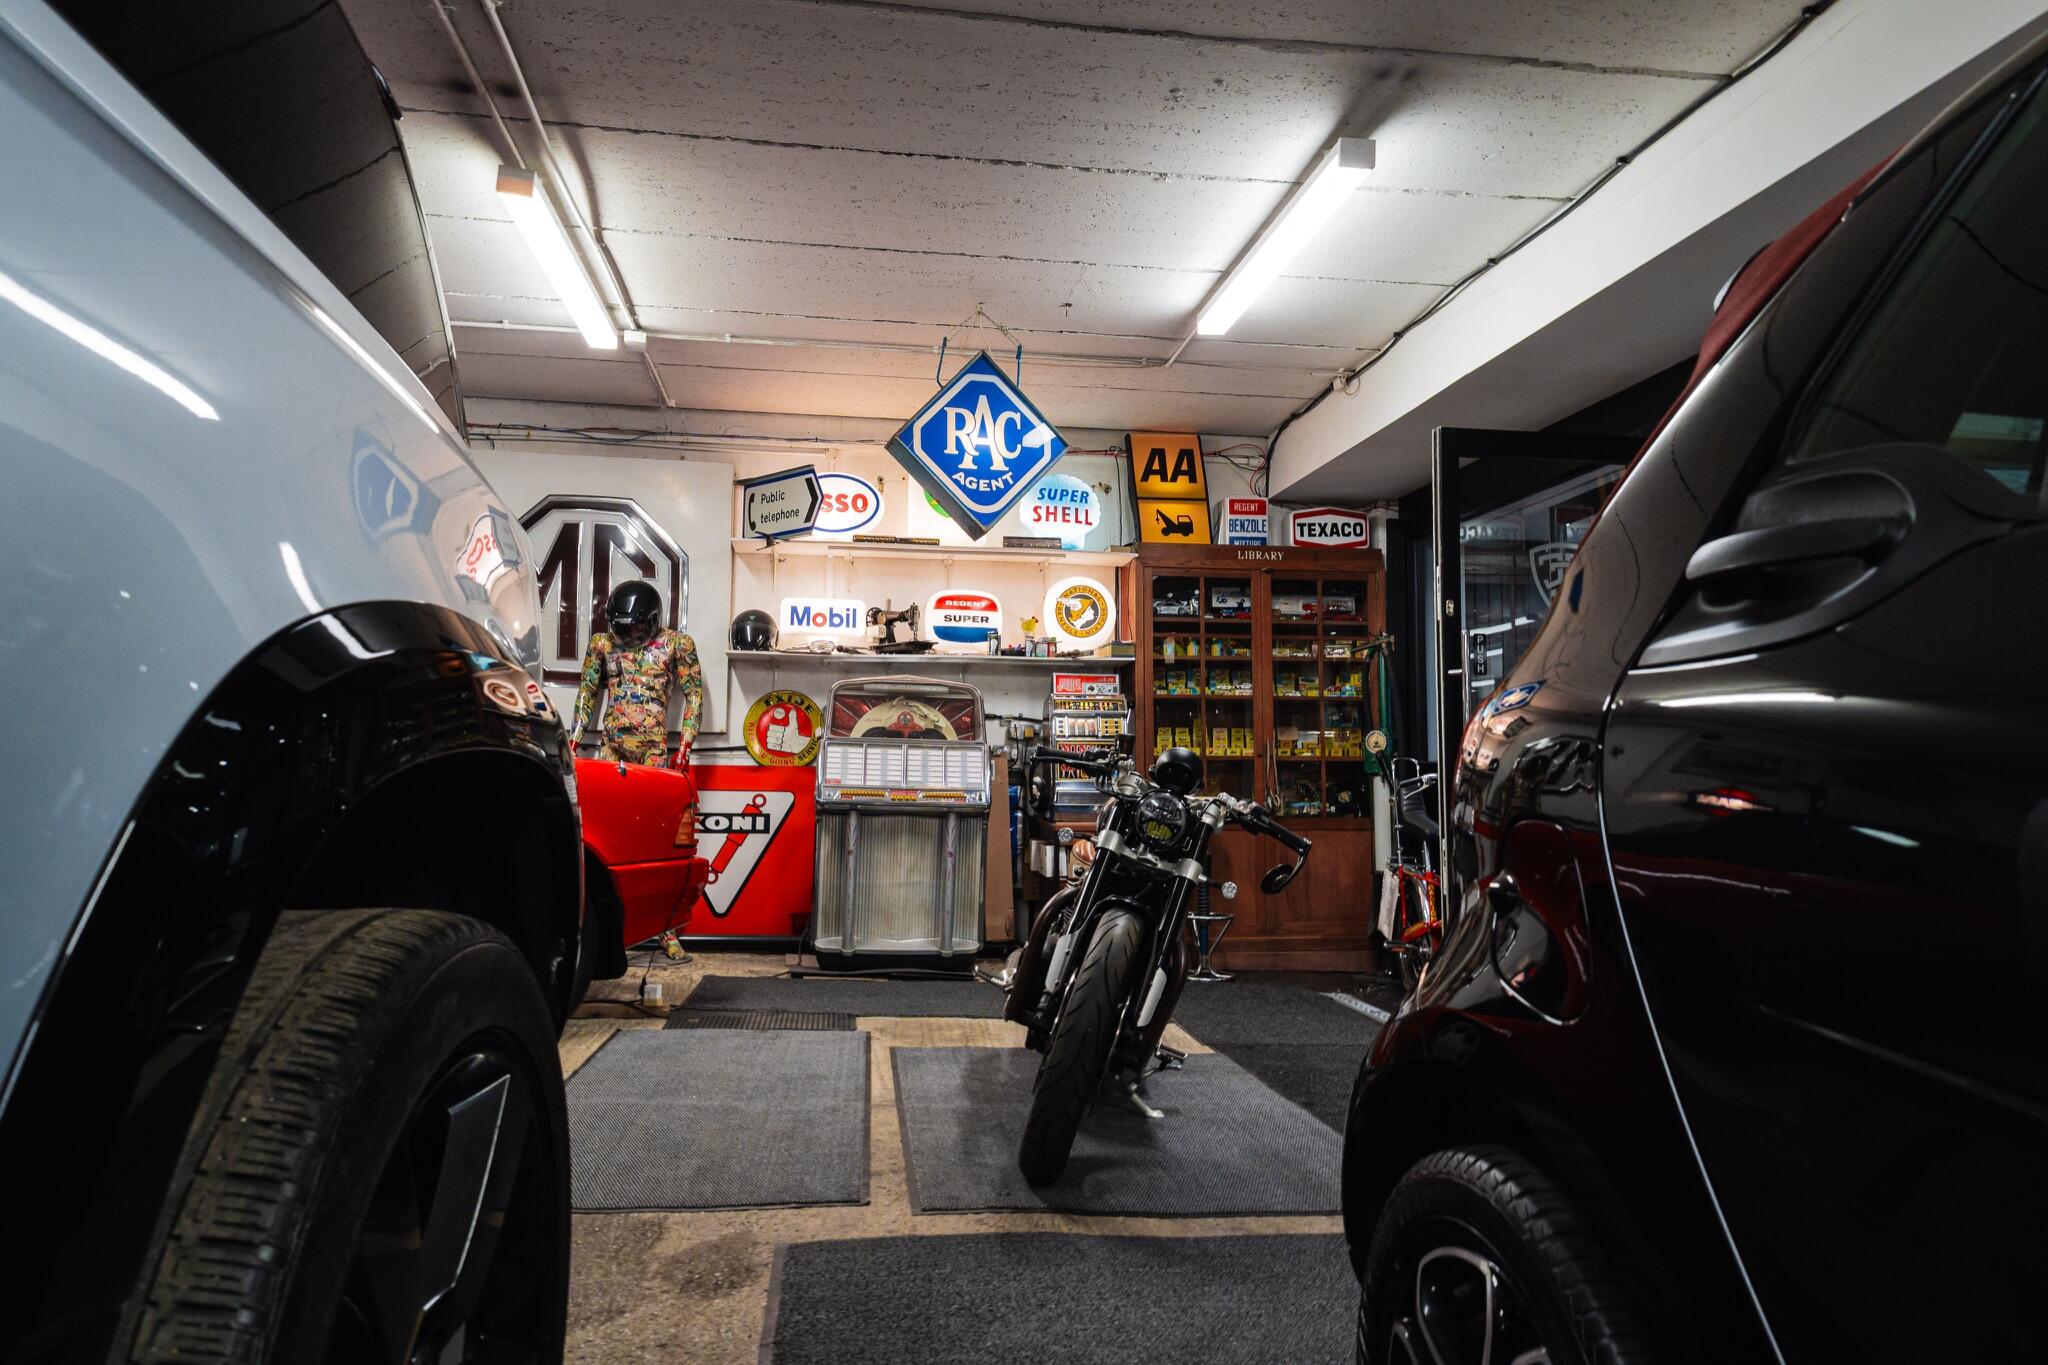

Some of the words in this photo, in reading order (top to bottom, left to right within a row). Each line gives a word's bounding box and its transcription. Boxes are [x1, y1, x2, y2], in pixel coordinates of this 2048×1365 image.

[943, 394, 1022, 471] RAC
[1140, 448, 1198, 484] AA
[951, 470, 1016, 493] AGENT
[760, 490, 786, 505] Public
[1037, 487, 1090, 505] SUPER
[760, 507, 800, 524] telephone
[1032, 504, 1093, 527] SHELL
[1233, 502, 1258, 512] REGENT
[1228, 518, 1267, 534] BENZOLE
[1296, 522, 1364, 538] TEXACO
[1237, 550, 1285, 561] LIBRARY
[945, 599, 988, 608] REGENT
[790, 605, 857, 629] Mobil
[943, 614, 990, 623] SUPER
[1476, 635, 1485, 673] PUSH
[764, 694, 815, 714] EXIDE
[798, 736, 819, 761] SERVIC
